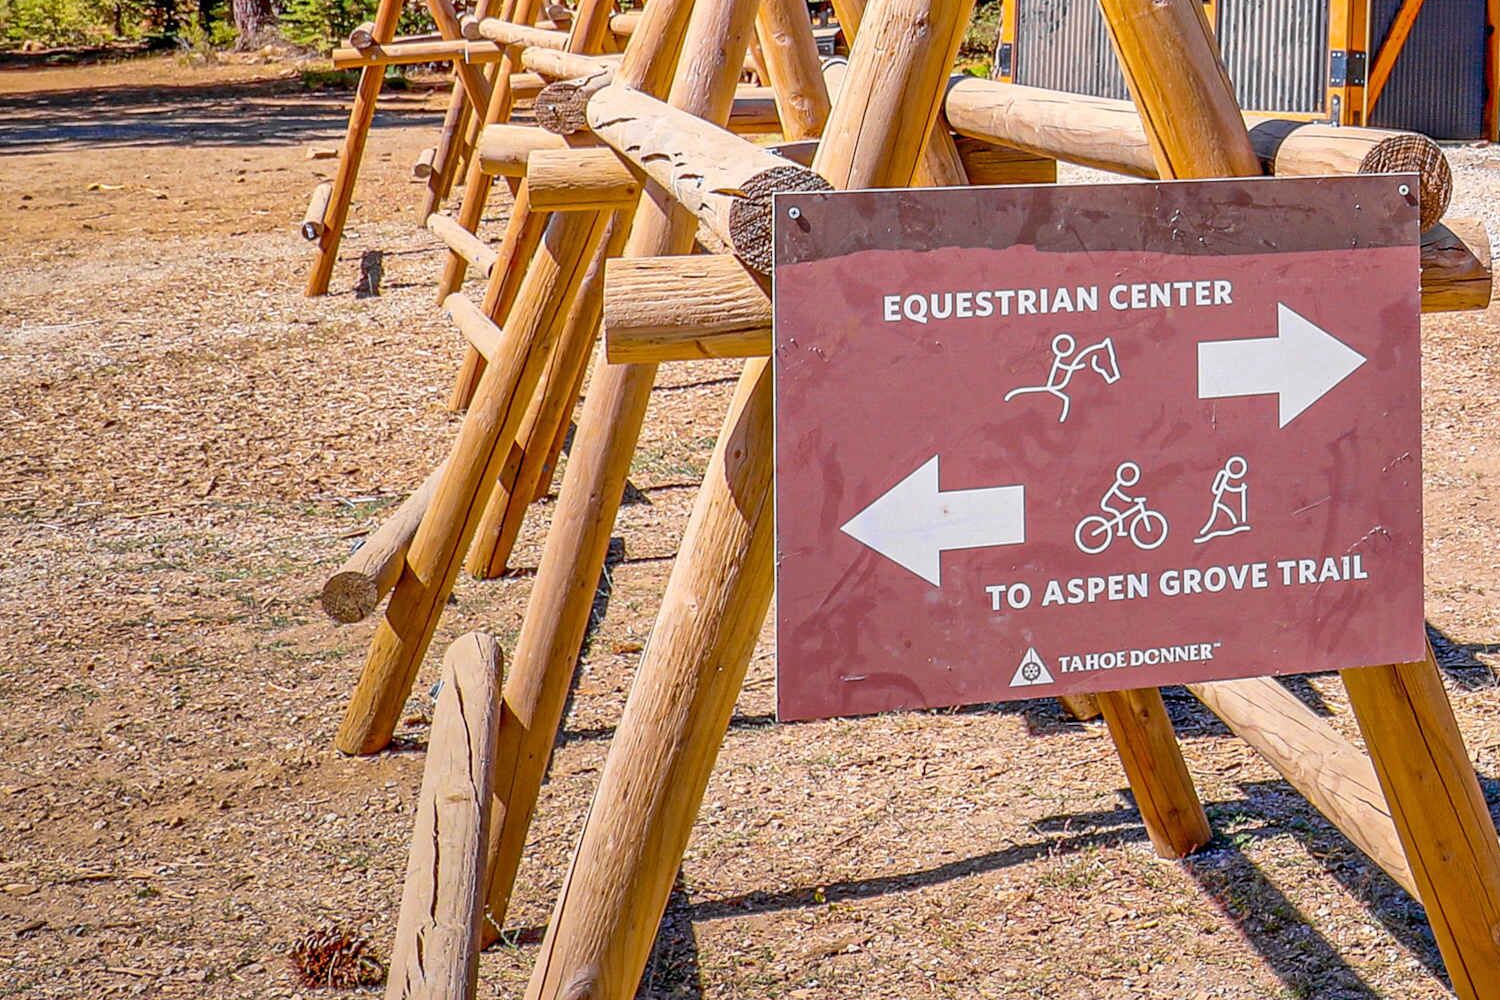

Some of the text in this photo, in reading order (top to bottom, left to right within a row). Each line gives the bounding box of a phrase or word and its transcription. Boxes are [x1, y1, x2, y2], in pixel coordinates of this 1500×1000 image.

[882, 279, 1234, 323] EQUESTRIAN CENTER
[986, 553, 1368, 611] TO ASPEN GROVE TRAIL
[1058, 651, 1127, 674] TAHOE
